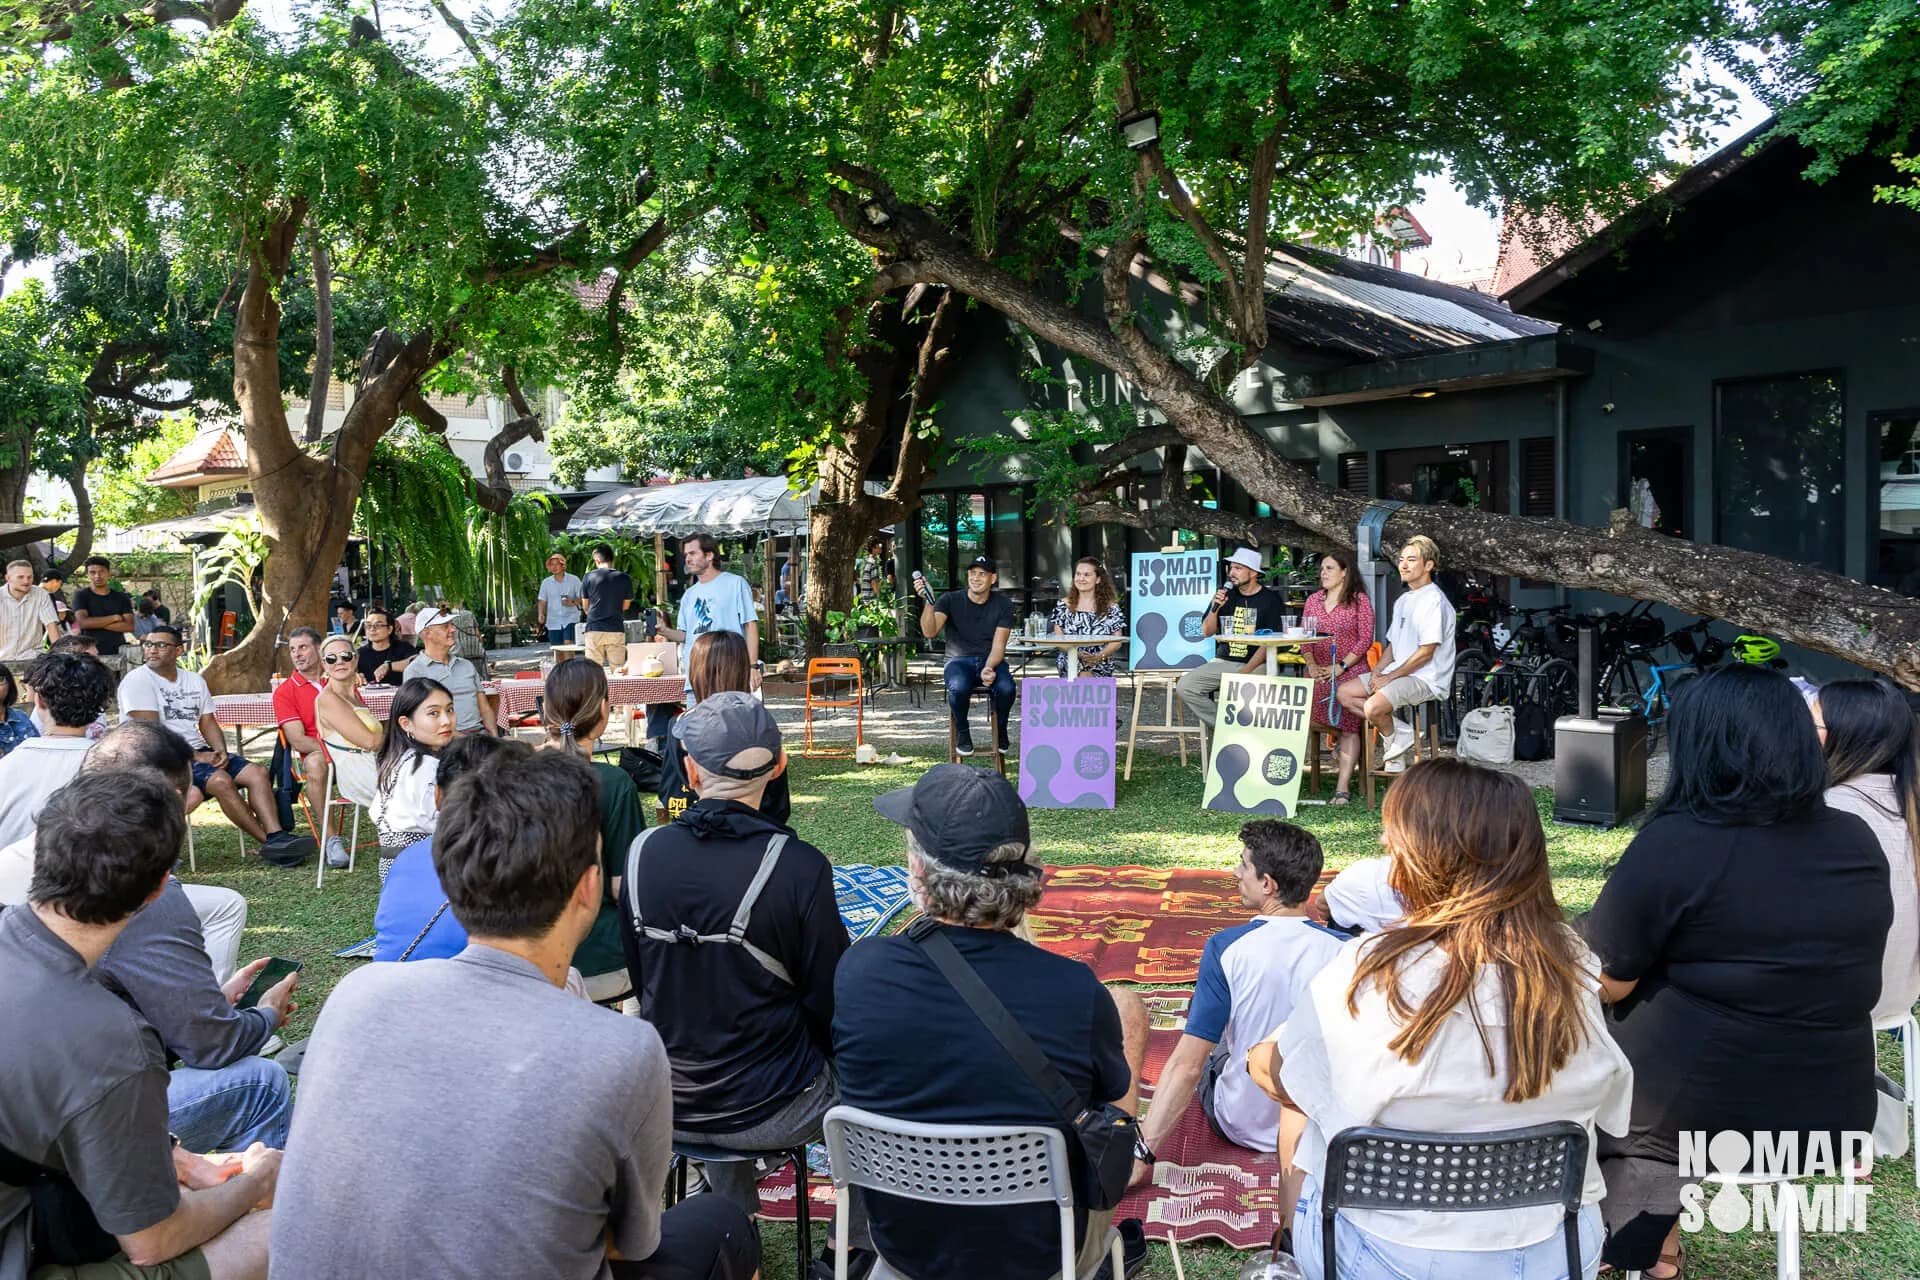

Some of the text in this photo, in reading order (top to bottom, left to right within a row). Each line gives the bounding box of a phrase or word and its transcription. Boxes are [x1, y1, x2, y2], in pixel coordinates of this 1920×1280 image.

[1138, 556, 1212, 577] NOMAD
[1029, 684, 1112, 705] NOMAD
[1227, 680, 1308, 707] NOMAD
